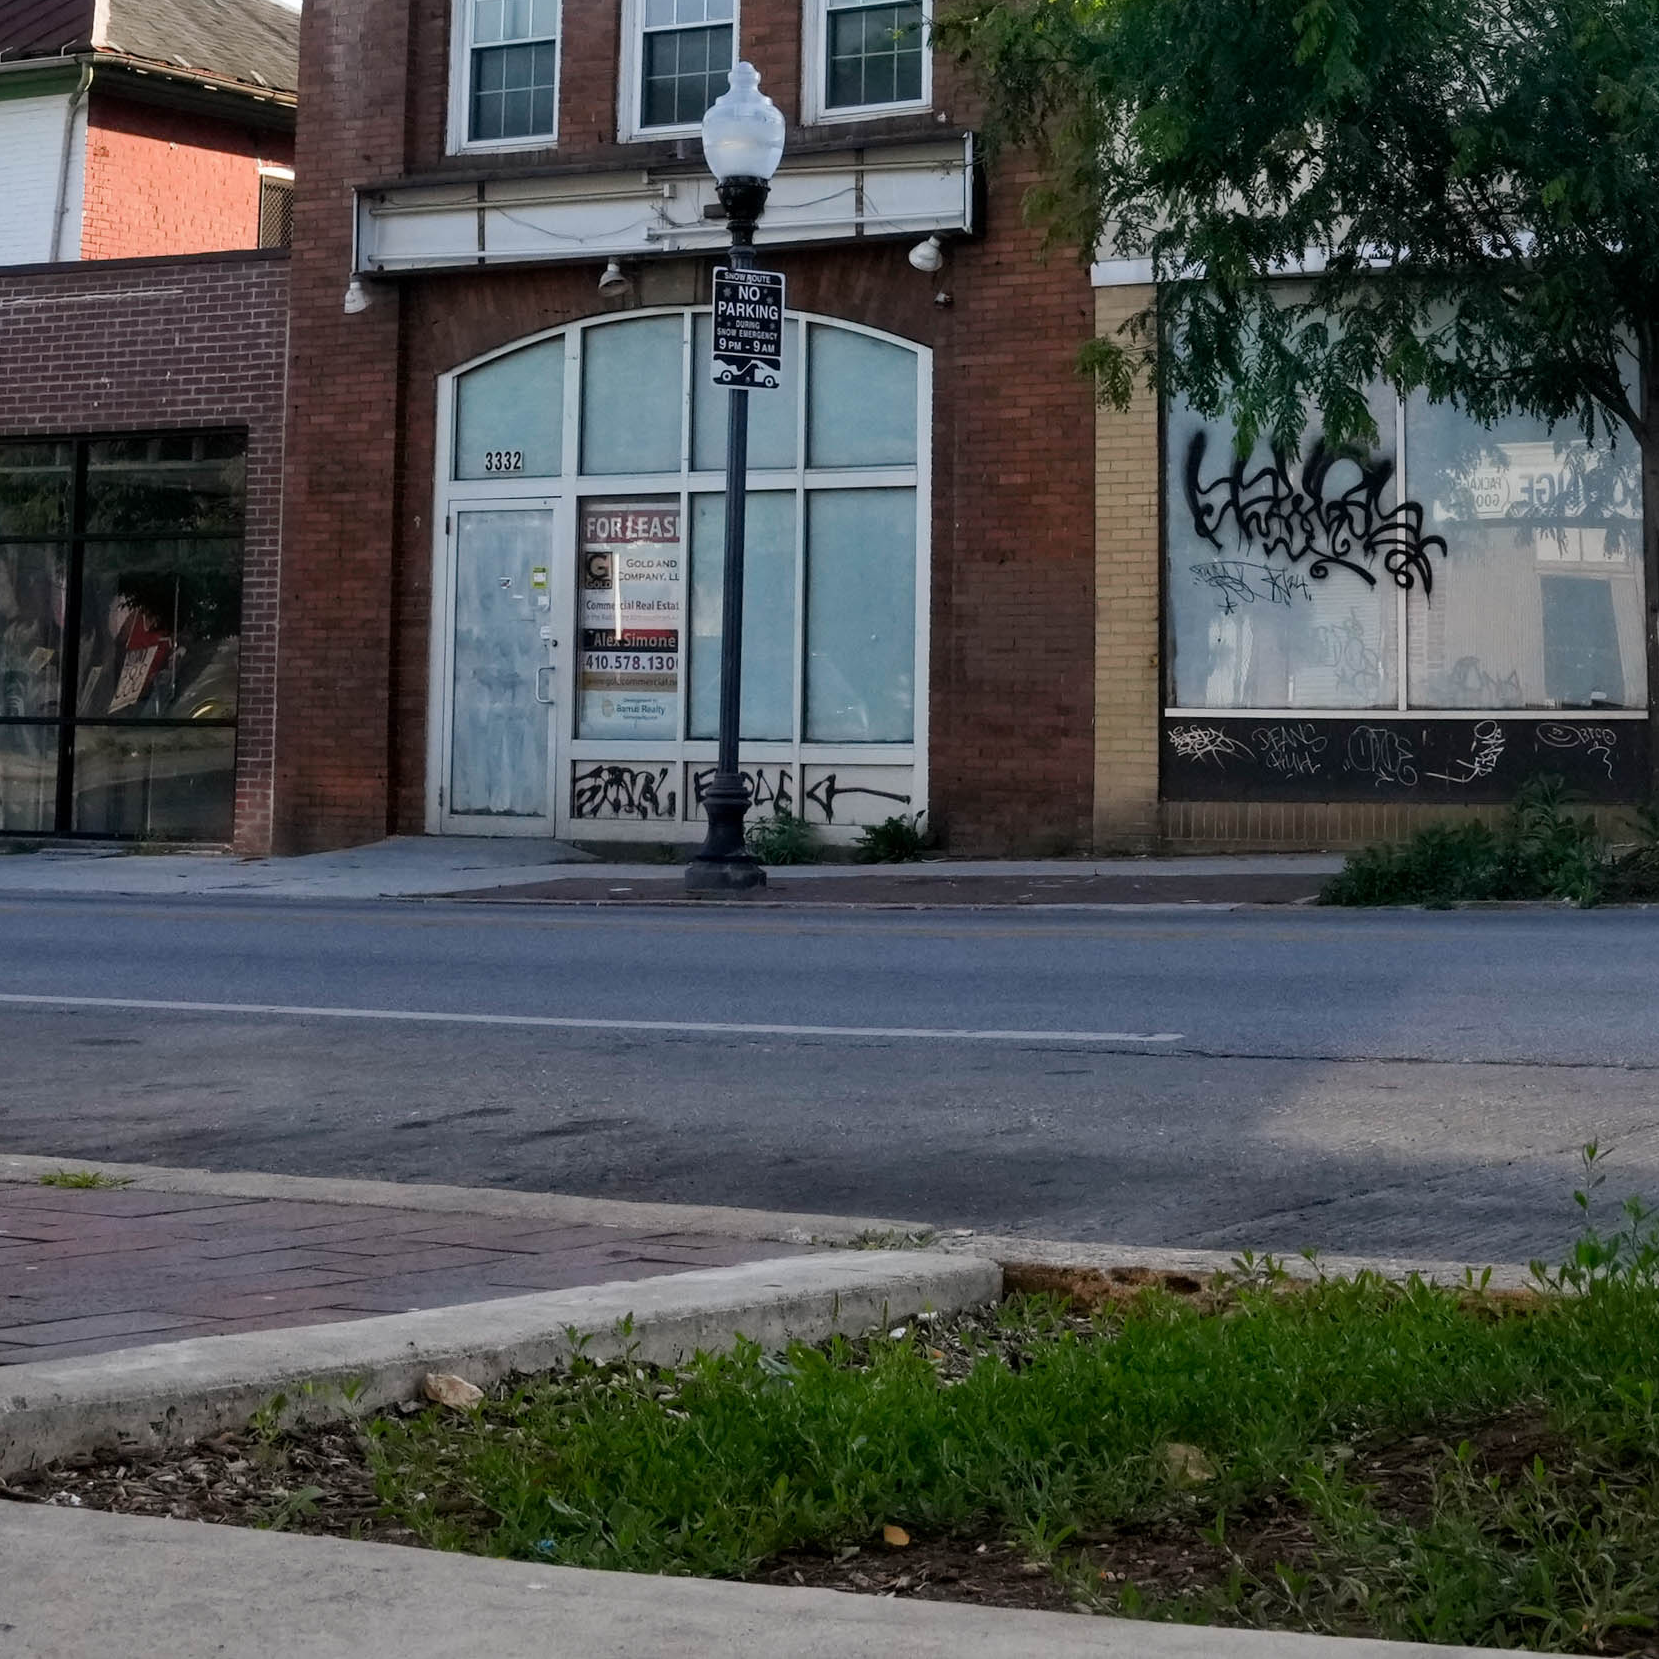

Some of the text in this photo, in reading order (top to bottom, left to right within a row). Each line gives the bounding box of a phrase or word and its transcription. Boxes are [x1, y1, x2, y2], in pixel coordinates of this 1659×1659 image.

[724, 271, 772, 283] SNOW ROUTE
[738, 285, 760, 301] NO
[718, 301, 779, 320] PARKING
[735, 320, 761, 330] DURING
[716, 327, 778, 341] SNOW EMERGENCY
[485, 451, 522, 471] 3332
[586, 516, 623, 538] FOR
[626, 559, 678, 568] GOLD AND
[586, 600, 634, 611] Commcial
[636, 601, 655, 611] Real
[593, 632, 676, 648] Alex Simone
